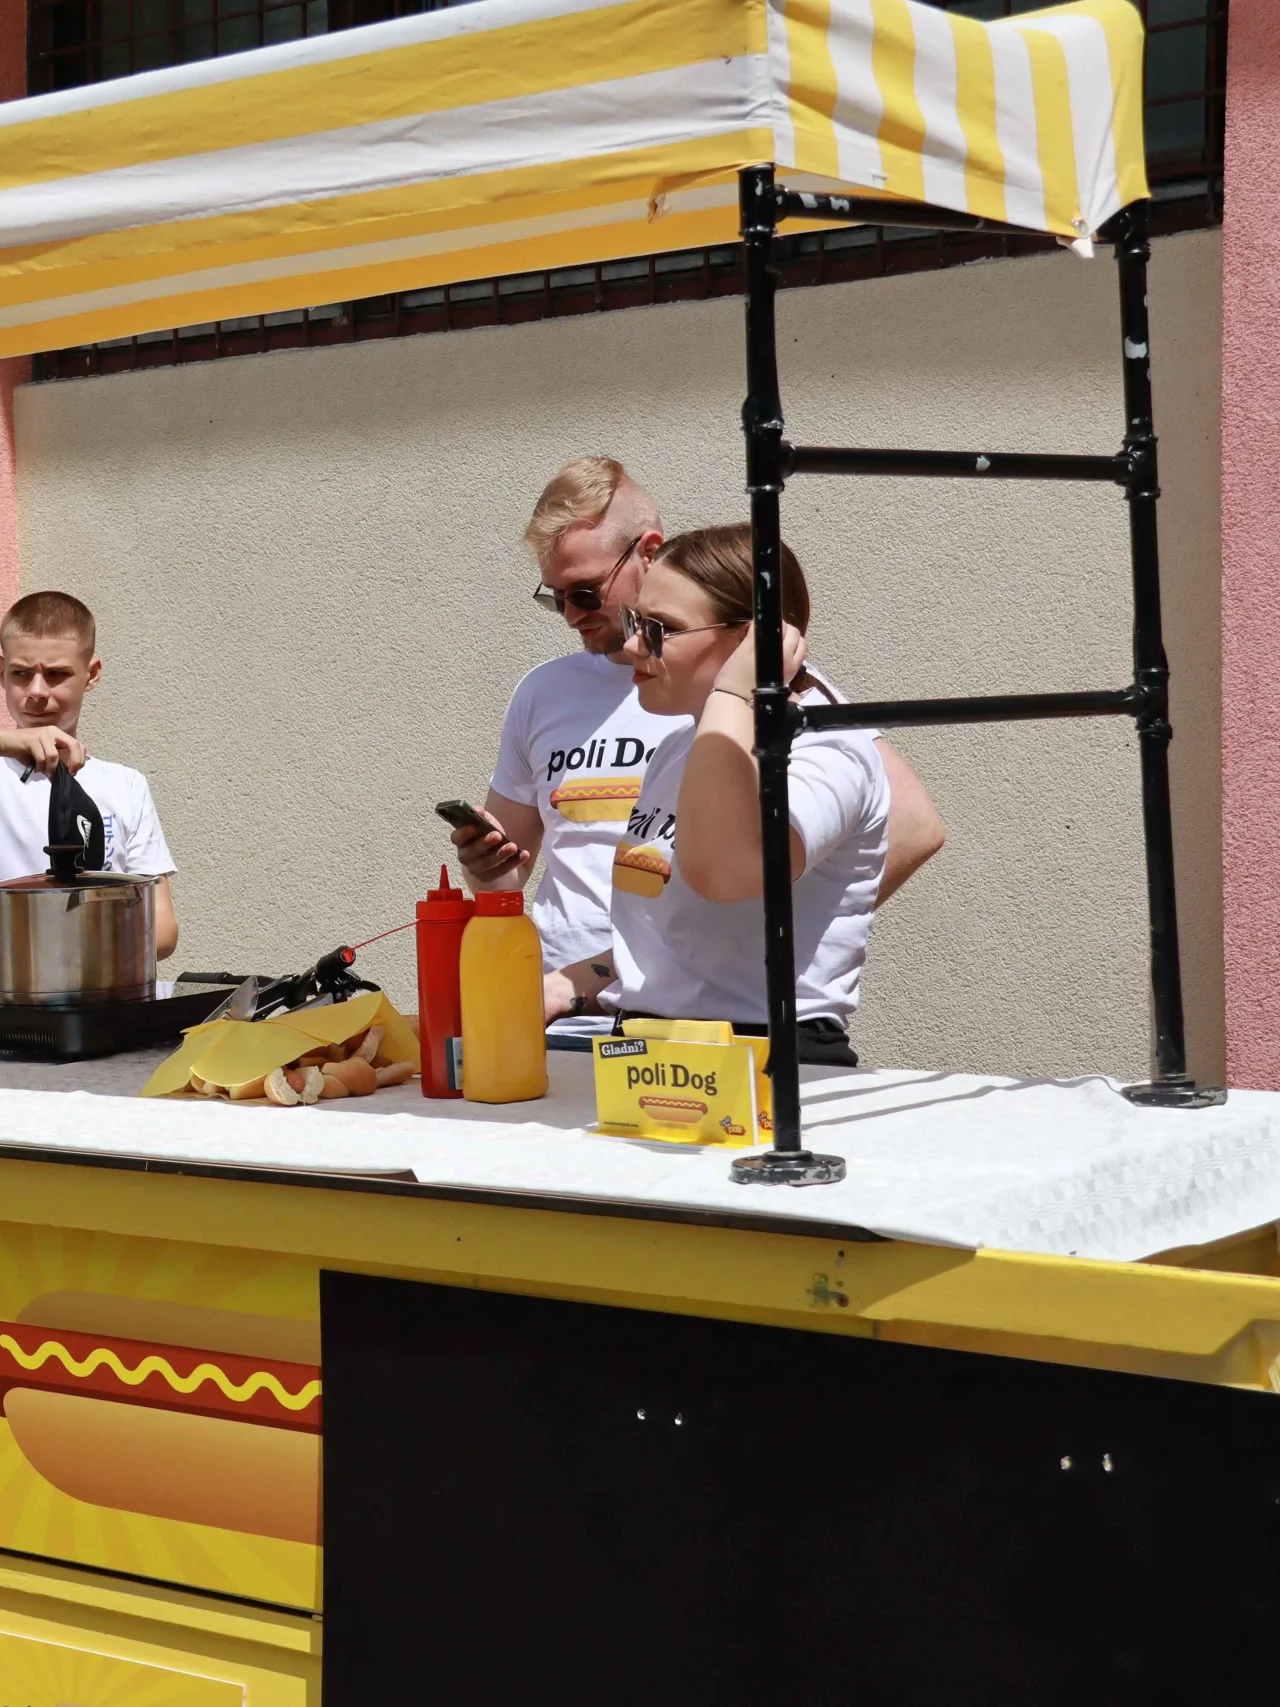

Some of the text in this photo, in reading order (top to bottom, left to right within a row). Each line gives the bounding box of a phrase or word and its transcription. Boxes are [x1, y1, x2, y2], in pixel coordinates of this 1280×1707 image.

[547, 738, 607, 781] poli
[627, 806, 662, 839] oli
[601, 1041, 645, 1056] Gladni?
[627, 1063, 718, 1096] poli Dog
